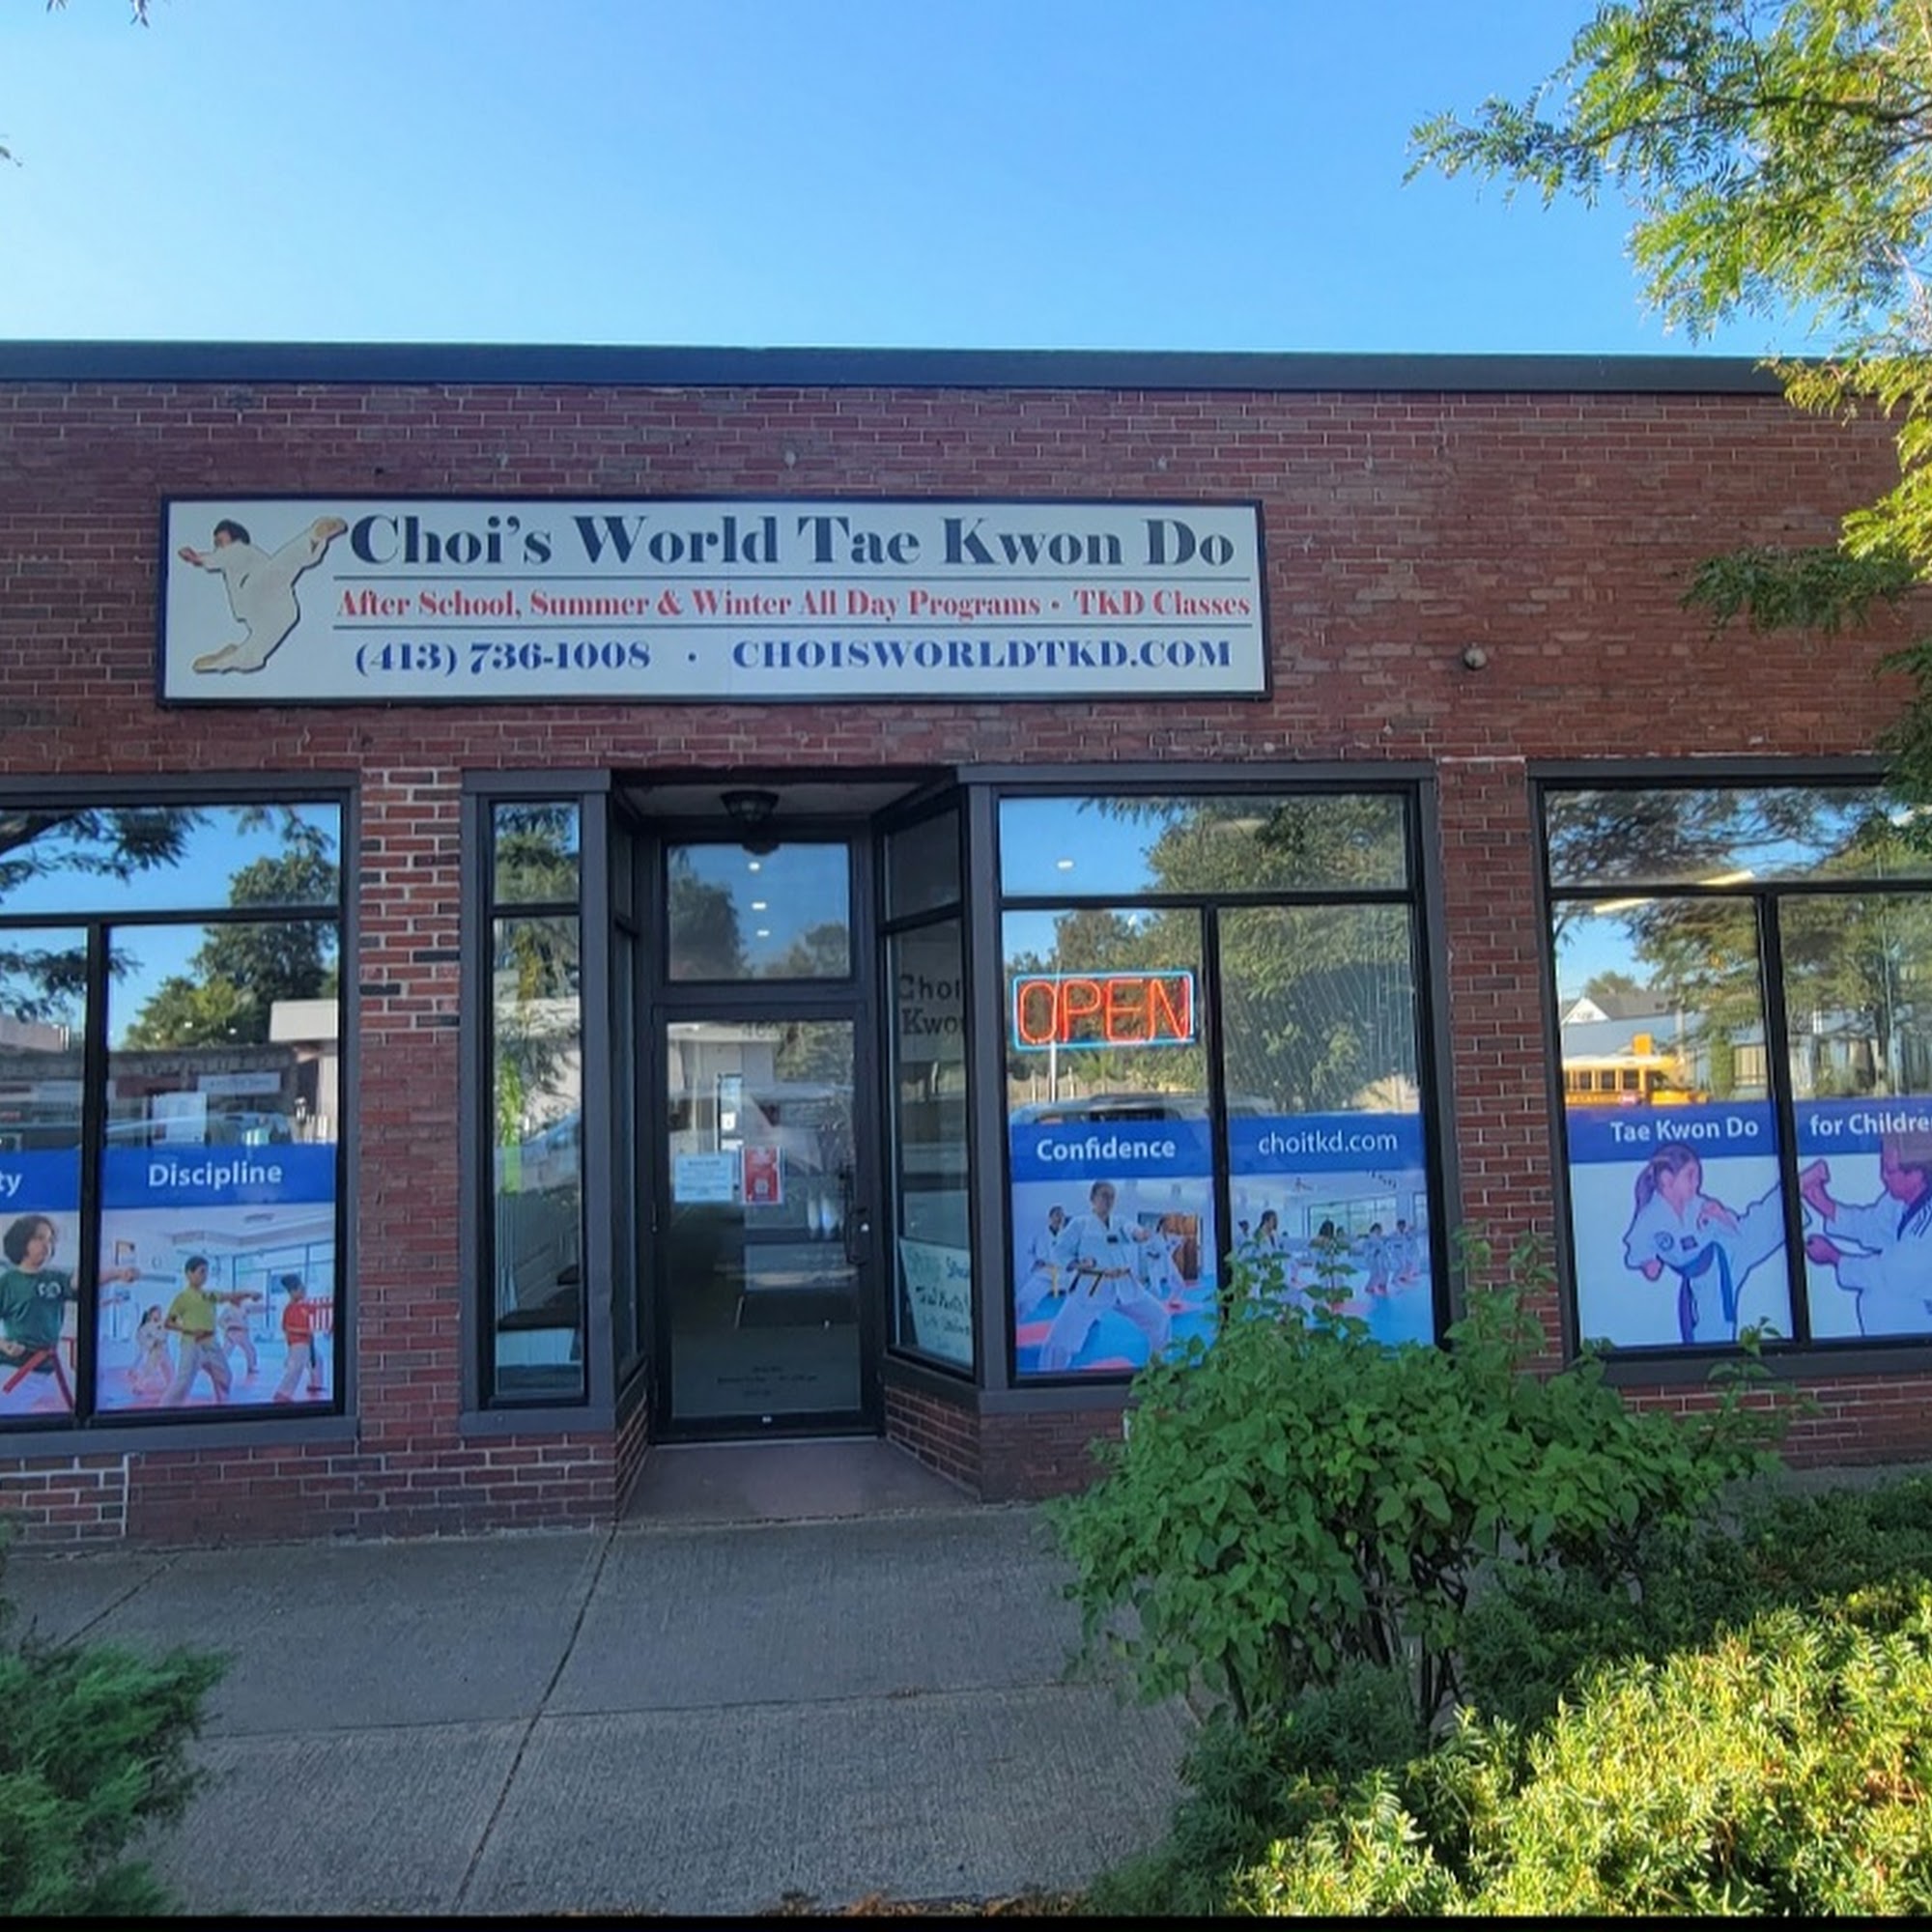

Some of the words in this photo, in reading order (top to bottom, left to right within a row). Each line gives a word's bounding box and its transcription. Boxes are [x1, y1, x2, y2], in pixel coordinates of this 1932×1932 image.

[350, 514, 553, 565] Choi's
[573, 514, 778, 565] World
[797, 515, 921, 566] Tae
[938, 516, 1123, 566] Kwon
[1141, 518, 1236, 567] Do
[338, 588, 411, 617] After
[418, 588, 523, 619] School,
[530, 588, 650, 617] Summer
[657, 588, 684, 616] &
[691, 588, 792, 616] Winter
[798, 588, 838, 615] All
[846, 589, 899, 622] Day
[908, 588, 1041, 620] Programs
[1072, 588, 1146, 616] TKD
[1153, 588, 1252, 616] Classes
[355, 641, 458, 677] (413)
[469, 640, 651, 675] 736-1008
[732, 639, 1232, 668] CHOISWORLDTKD.COM
[901, 1008, 964, 1037] Kwo
[1019, 977, 1190, 1044] OPEN
[1609, 1121, 1651, 1144] Tae
[1656, 1119, 1721, 1142] Kwon
[1725, 1116, 1760, 1139] Do
[1810, 1113, 1844, 1138] for
[1849, 1111, 1932, 1136] Childre
[1036, 1135, 1177, 1162] Confidence
[1258, 1129, 1399, 1155] choitkd.com
[148, 1160, 283, 1190] Discipline
